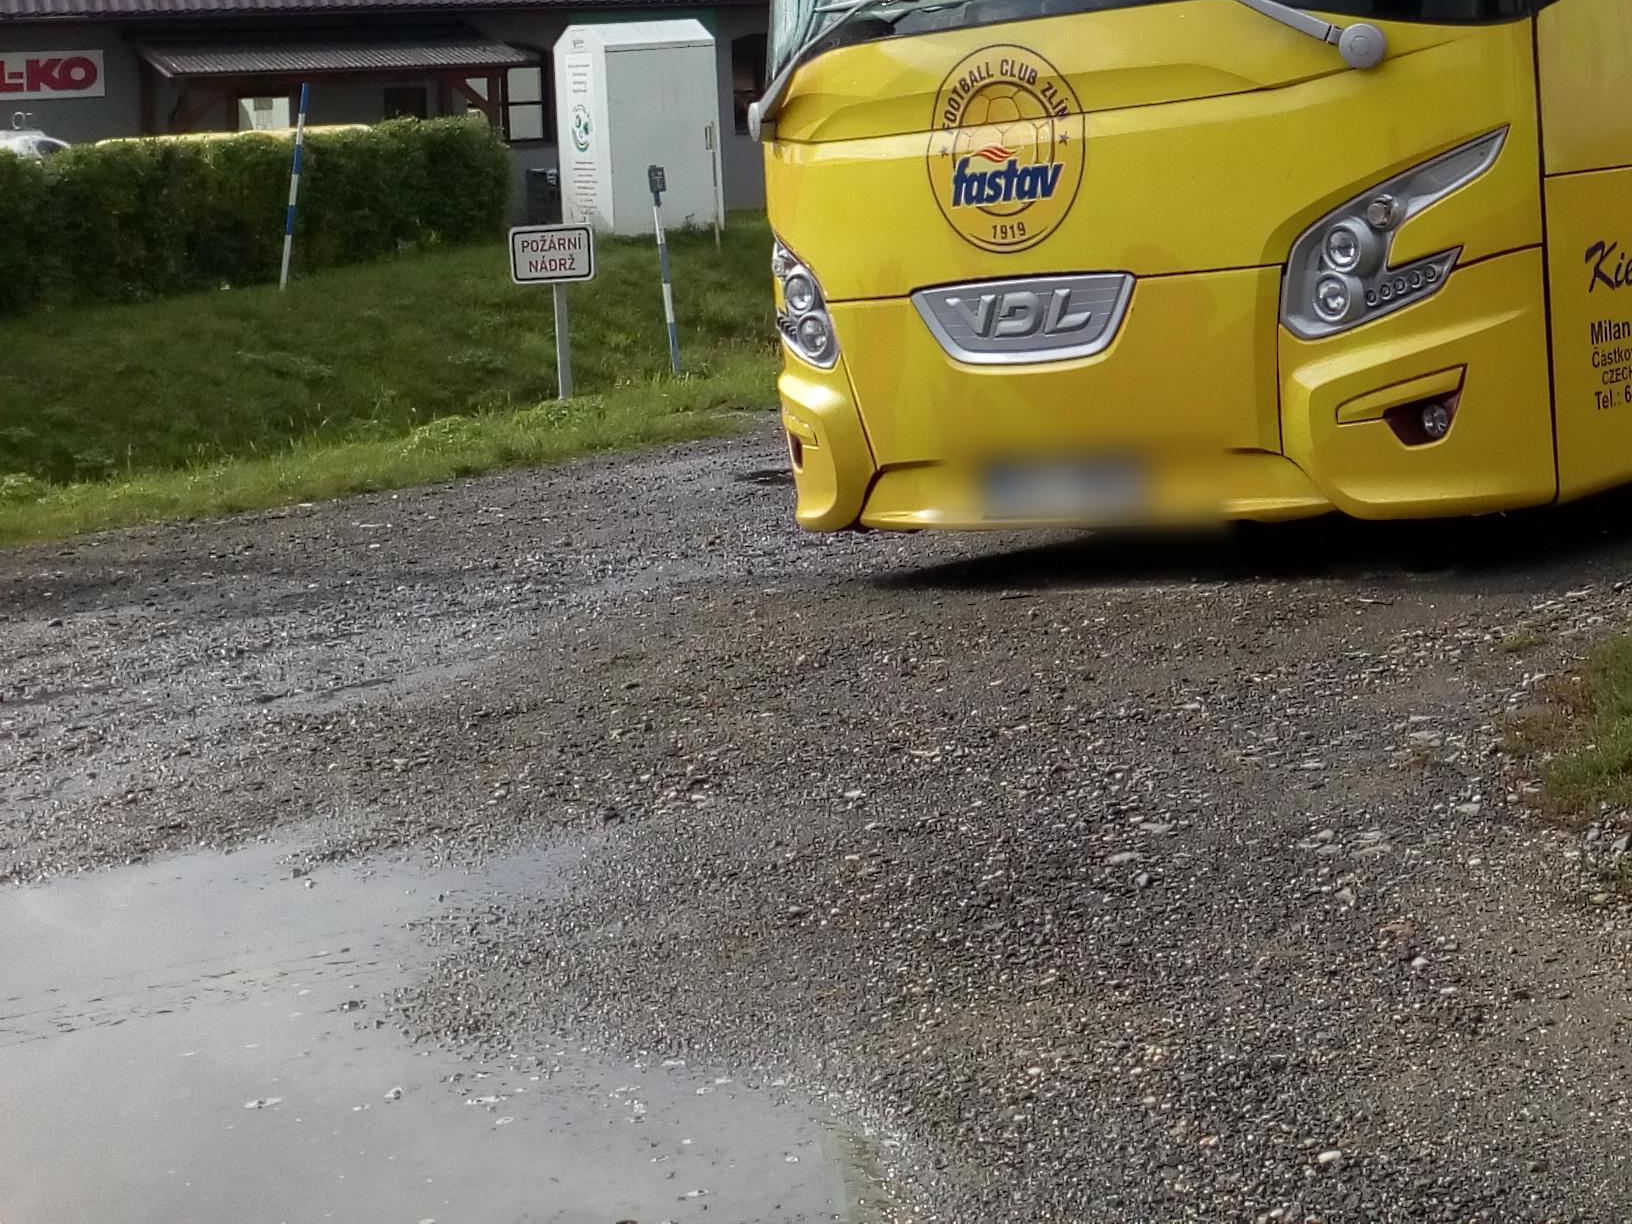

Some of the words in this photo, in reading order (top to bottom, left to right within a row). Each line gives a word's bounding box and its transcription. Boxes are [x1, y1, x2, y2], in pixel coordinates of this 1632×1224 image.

[943, 61, 995, 133] FOOTBALL
[1000, 59, 1038, 85] CLUB
[951, 155, 1065, 208] fastav
[521, 232, 582, 254] POŽÁRNÍ
[991, 221, 1027, 241] 1919
[528, 254, 576, 273] NÁDRŽ
[945, 288, 1092, 339] VDL
[1590, 319, 1631, 346] Milan
